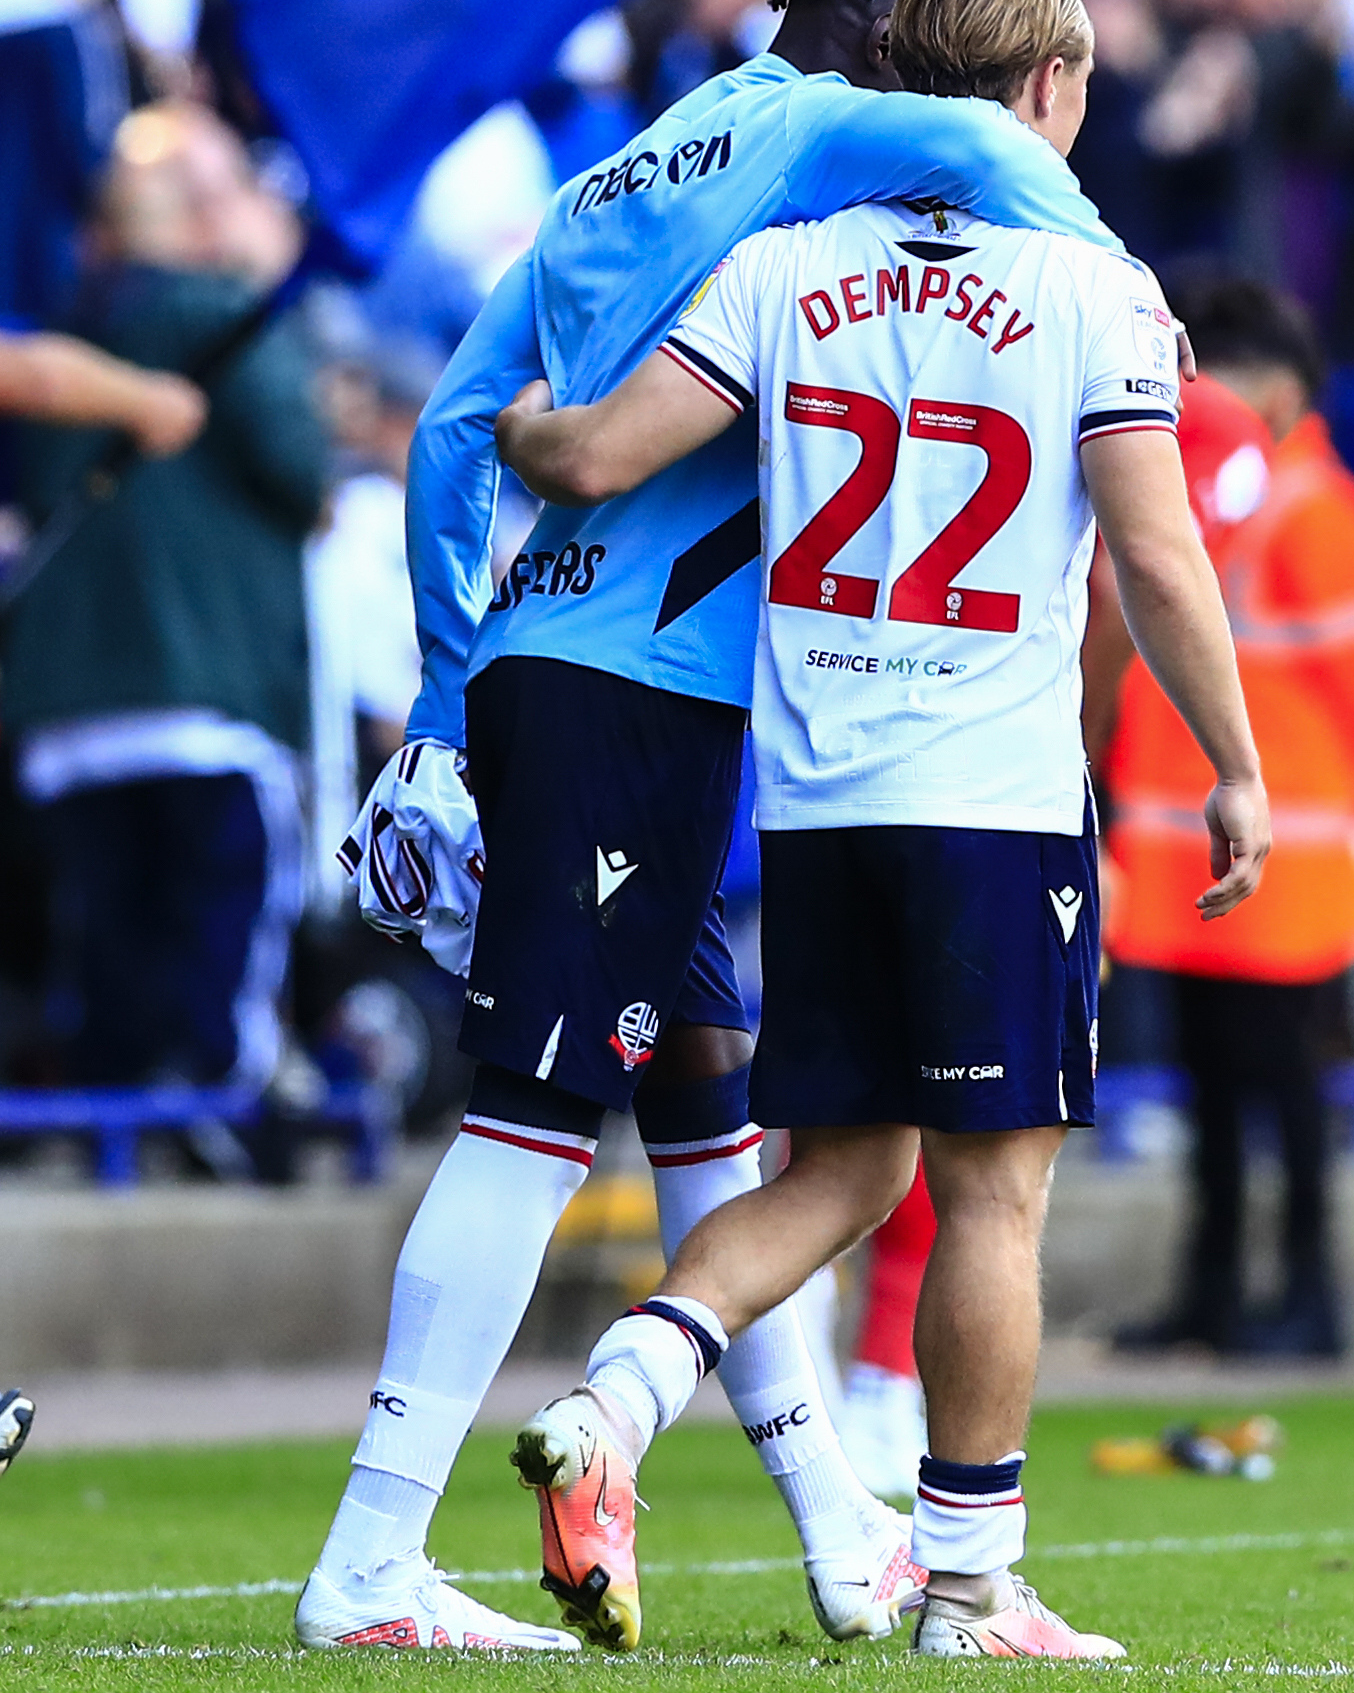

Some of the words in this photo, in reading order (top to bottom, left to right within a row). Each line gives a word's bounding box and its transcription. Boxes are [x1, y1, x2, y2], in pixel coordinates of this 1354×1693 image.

[798, 264, 1035, 355] DEMPSEY
[768, 381, 1032, 633] 22
[820, 595, 834, 606] EFL
[946, 610, 959, 620] EFL
[805, 649, 880, 673] SERVICE
[885, 658, 919, 675] MY
[943, 1066, 966, 1081] MY
